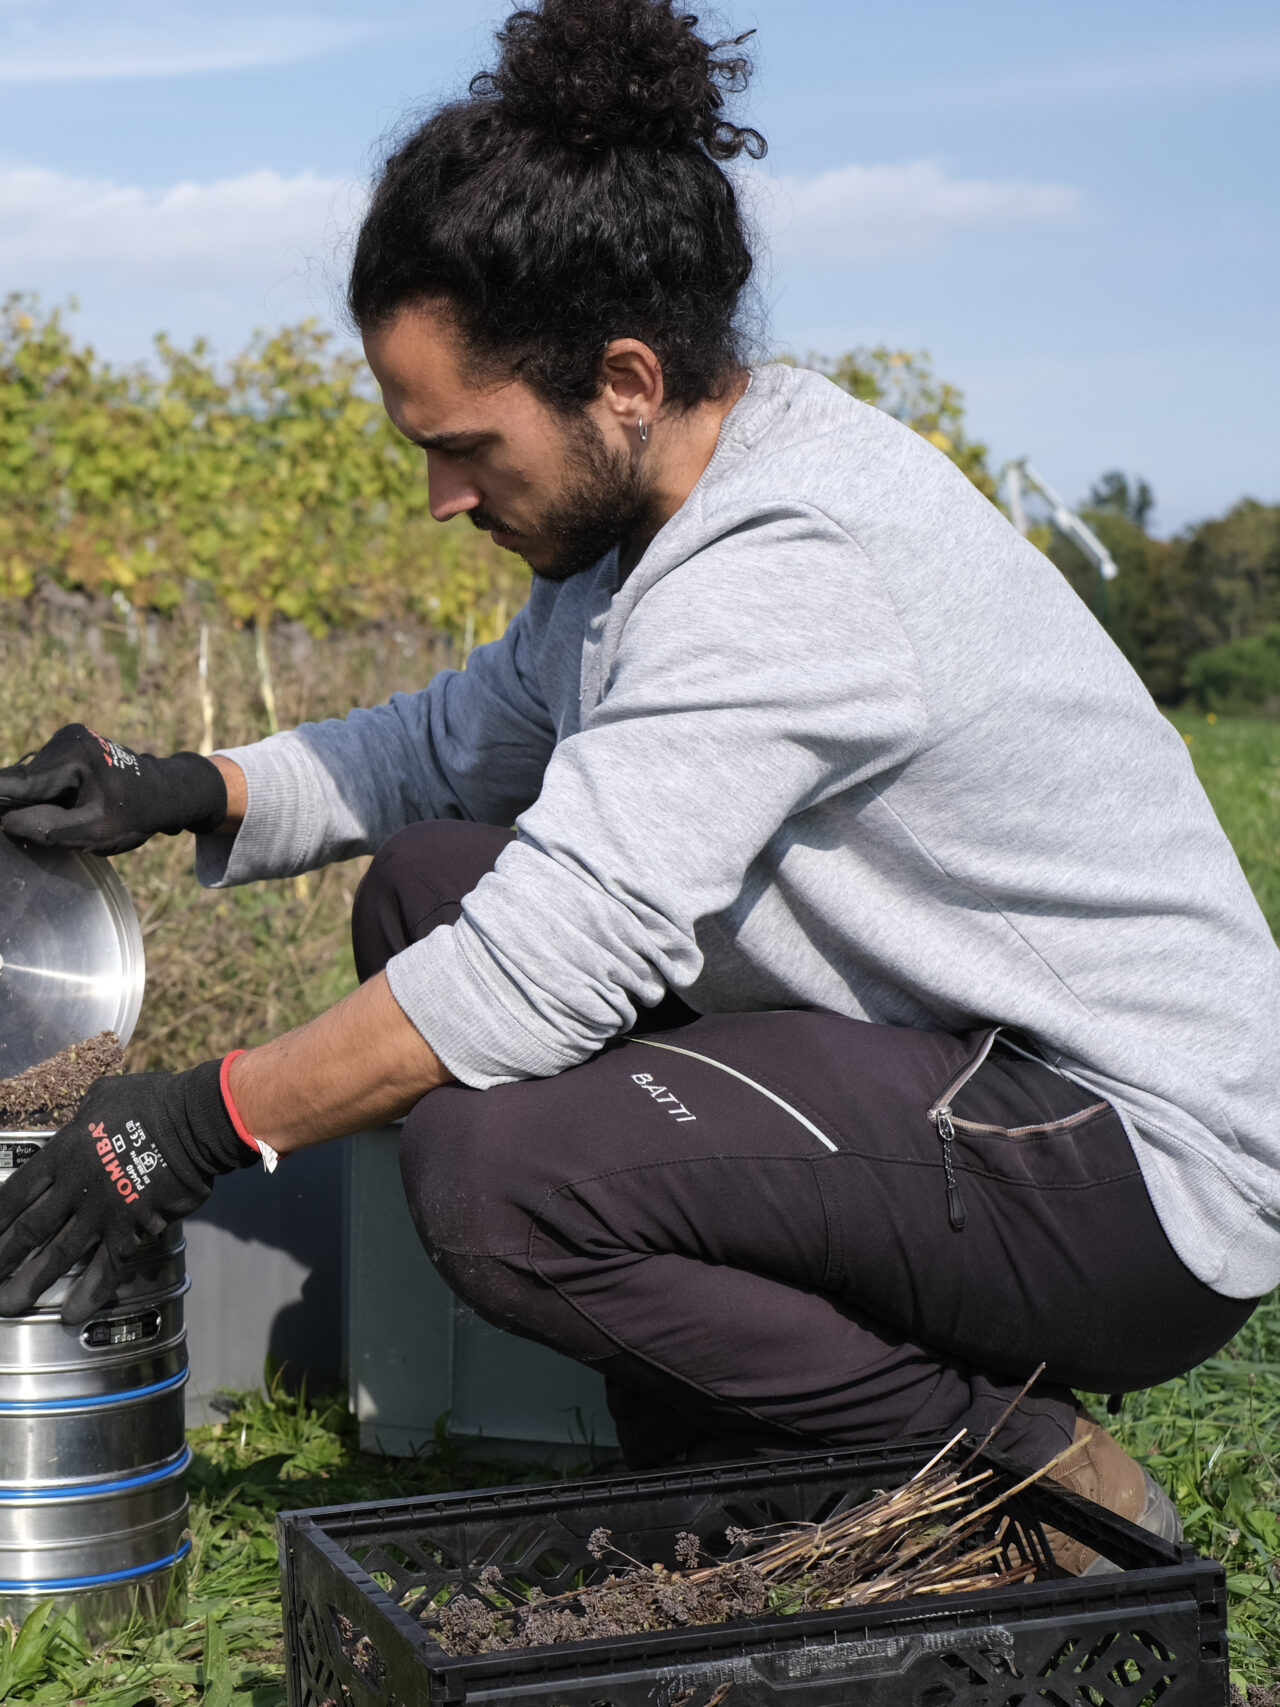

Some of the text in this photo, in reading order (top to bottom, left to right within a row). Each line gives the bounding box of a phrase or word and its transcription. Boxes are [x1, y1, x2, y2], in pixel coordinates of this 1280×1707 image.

[631, 1073, 697, 1122] BATTI
[126, 1164, 146, 1191] PU440
[142, 1174, 151, 1185] EN
